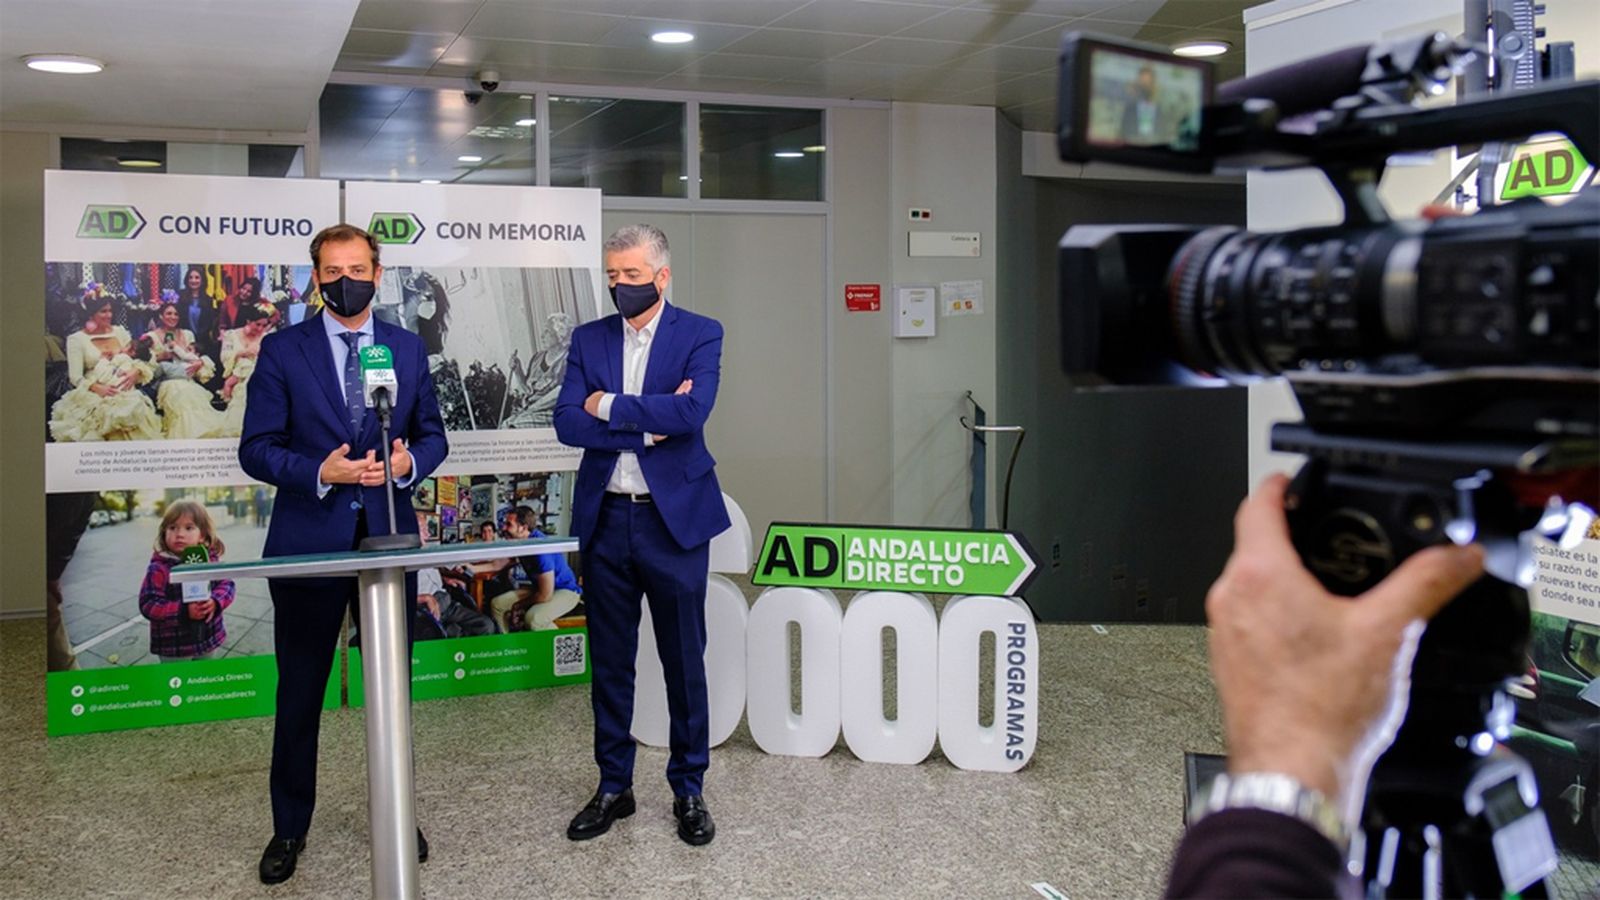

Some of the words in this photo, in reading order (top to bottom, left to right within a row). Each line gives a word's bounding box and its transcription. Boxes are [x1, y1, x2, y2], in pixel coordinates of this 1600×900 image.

[1510, 149, 1574, 190] AD
[84, 210, 129, 234] AD
[159, 215, 211, 235] CON
[219, 217, 313, 237] FUTURO
[372, 218, 410, 240] AD
[436, 221, 481, 239] CON
[489, 223, 586, 241] MEMORIA
[762, 535, 839, 578] AD
[1573, 552, 1586, 562] es
[1587, 553, 1598, 564] la
[847, 561, 964, 586] DIRECTO
[1539, 560, 1551, 569] su
[1553, 562, 1583, 575] razón
[1584, 568, 1599, 578] de
[1540, 574, 1576, 589] nuevas
[1541, 588, 1575, 603] donde
[1576, 596, 1595, 607] sea
[226, 673, 254, 682] Directo
[1006, 622, 1027, 761] PROGRAMAS
